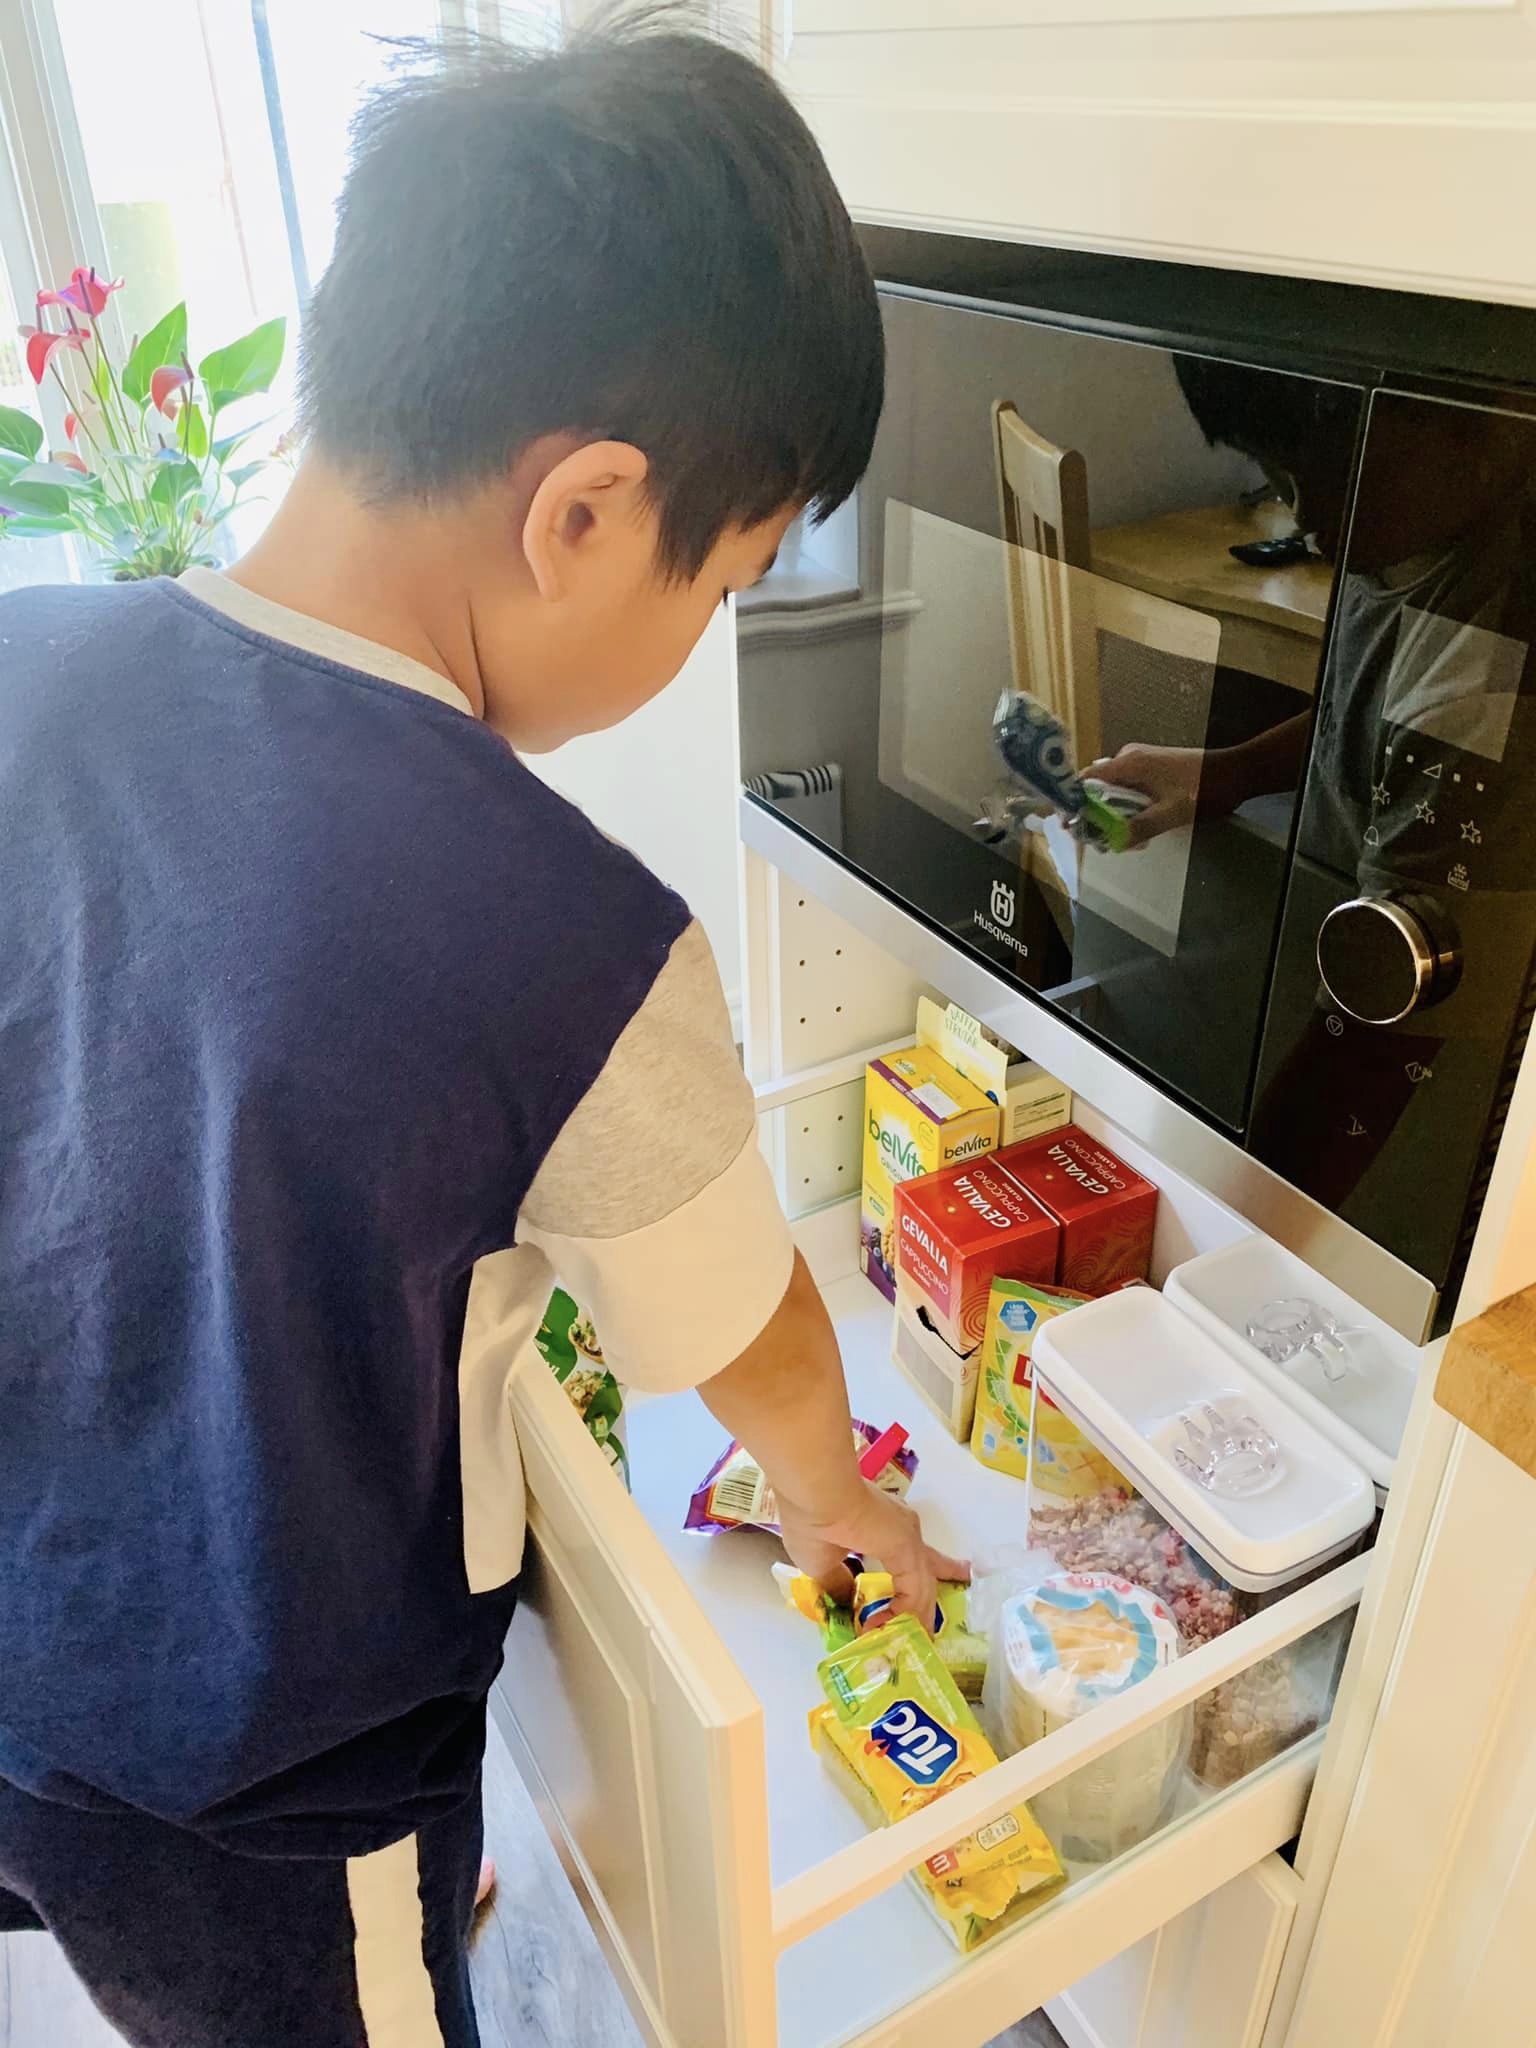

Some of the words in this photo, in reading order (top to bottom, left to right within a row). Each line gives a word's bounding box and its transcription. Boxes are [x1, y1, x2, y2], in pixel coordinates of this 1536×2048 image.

[973, 909, 1029, 957] Husqvarna
[944, 1135, 991, 1159] belVita
[1047, 1144, 1109, 1194] GEVALIA
[1065, 1140, 1126, 1189] CAPPUCCINO
[953, 1175, 1011, 1228] GEVALIA
[973, 1170, 1029, 1222] CAPPUCCINO
[901, 1215, 949, 1276] GEVALIA
[881, 1706, 952, 1775] TUC
